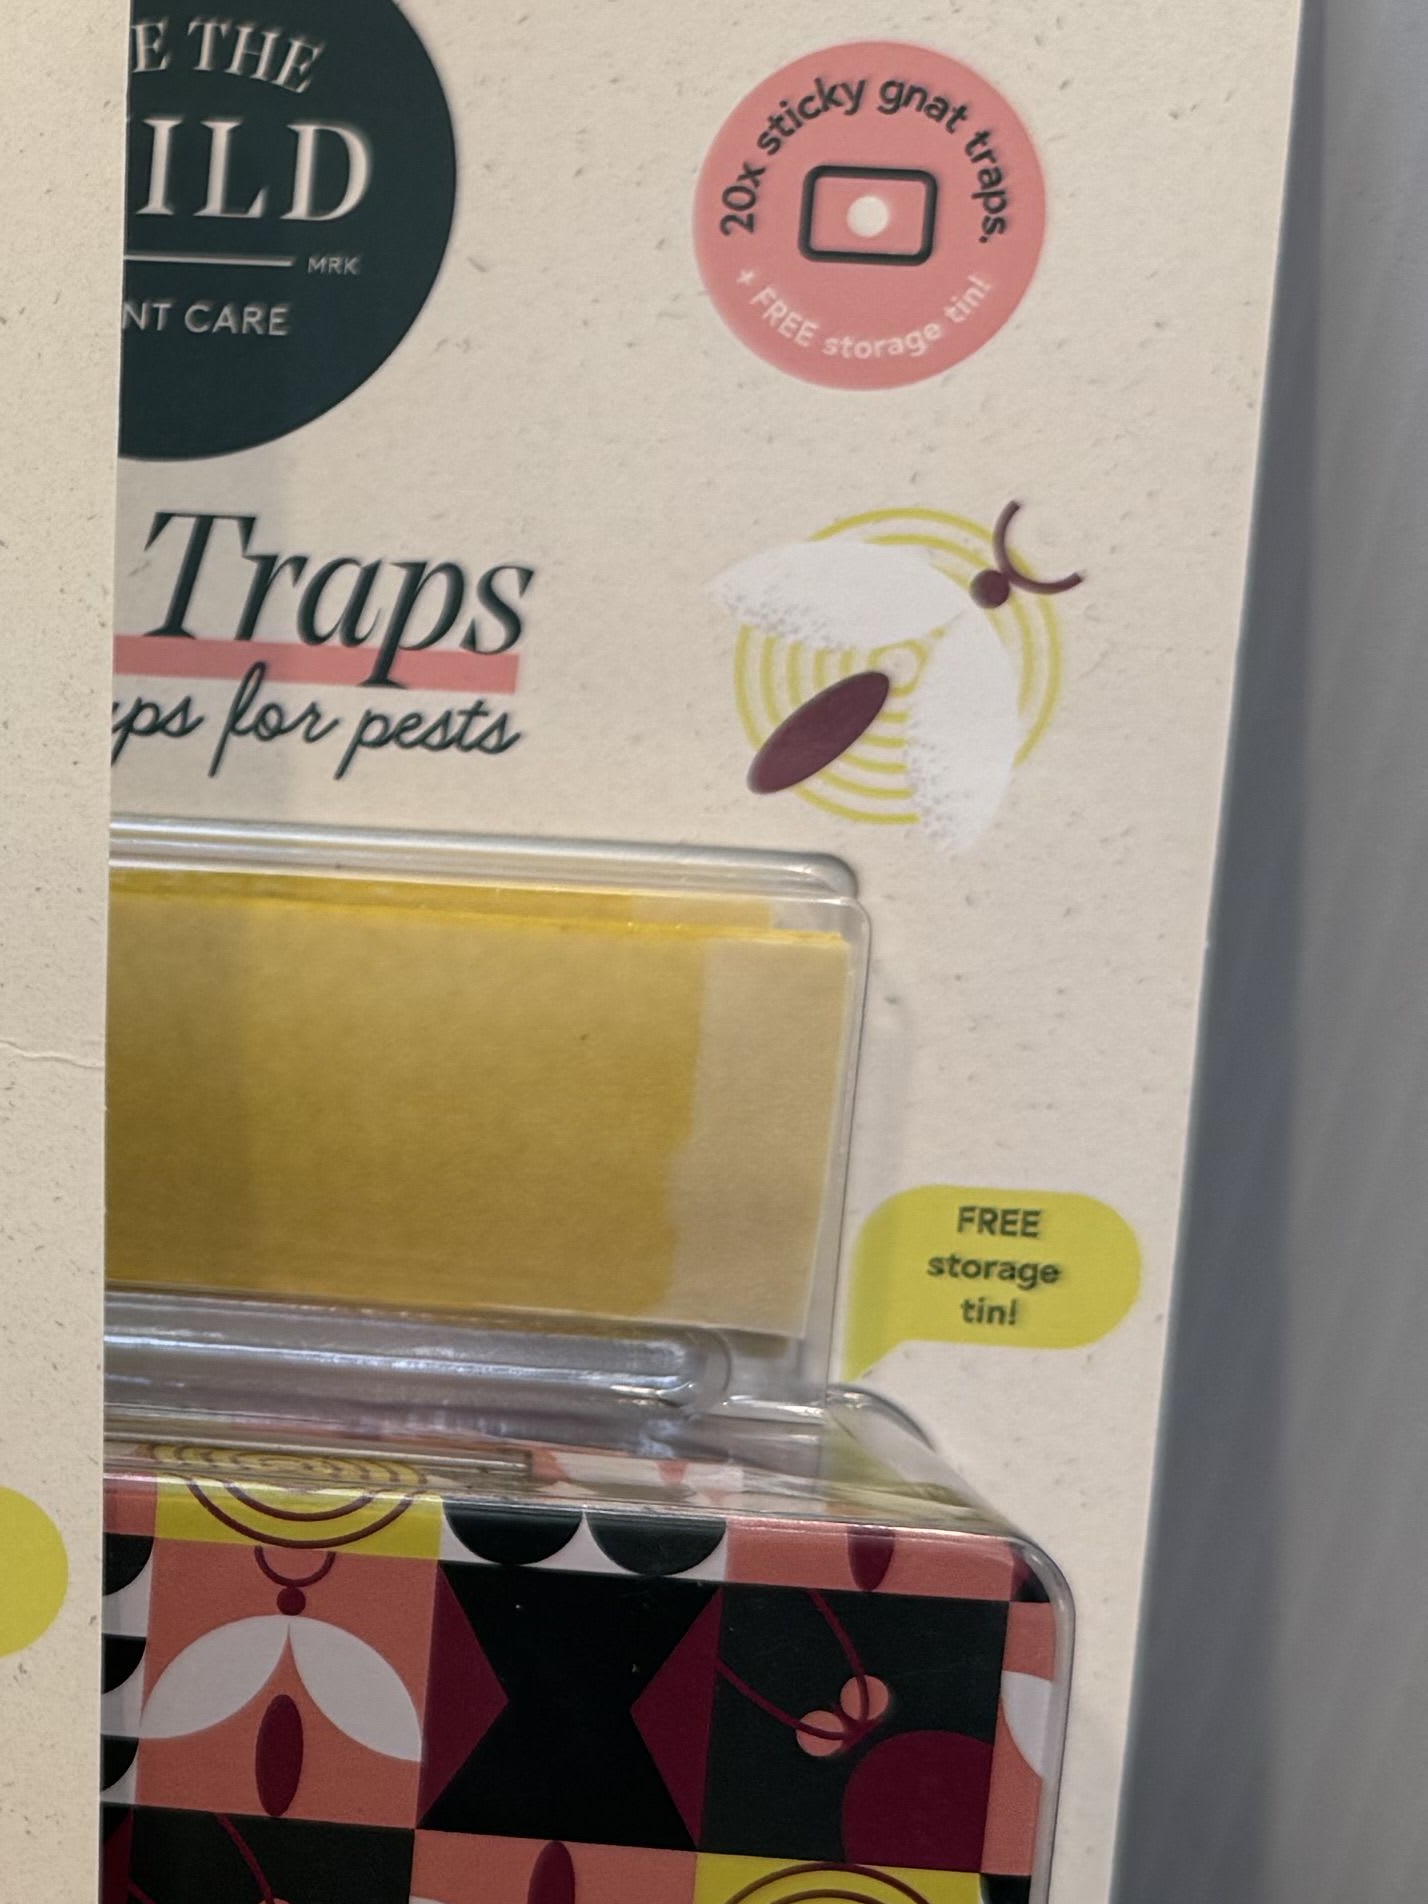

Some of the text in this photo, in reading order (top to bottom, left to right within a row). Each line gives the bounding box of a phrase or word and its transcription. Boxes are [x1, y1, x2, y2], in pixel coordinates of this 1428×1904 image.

[187, 17, 325, 94] THE
[129, 115, 373, 222] ILD
[719, 77, 1008, 244] 20x sticky gnat traps.
[307, 256, 361, 276] MRK
[184, 302, 290, 336] CARE
[749, 285, 820, 347] FREE
[822, 322, 942, 359] storage
[945, 274, 992, 323] tin!
[142, 511, 536, 690] Traps
[208, 660, 339, 778] for
[334, 698, 522, 780] pests
[957, 1206, 1041, 1238] FREE
[927, 1254, 1062, 1291] storage
[961, 1297, 1018, 1325] tin!
